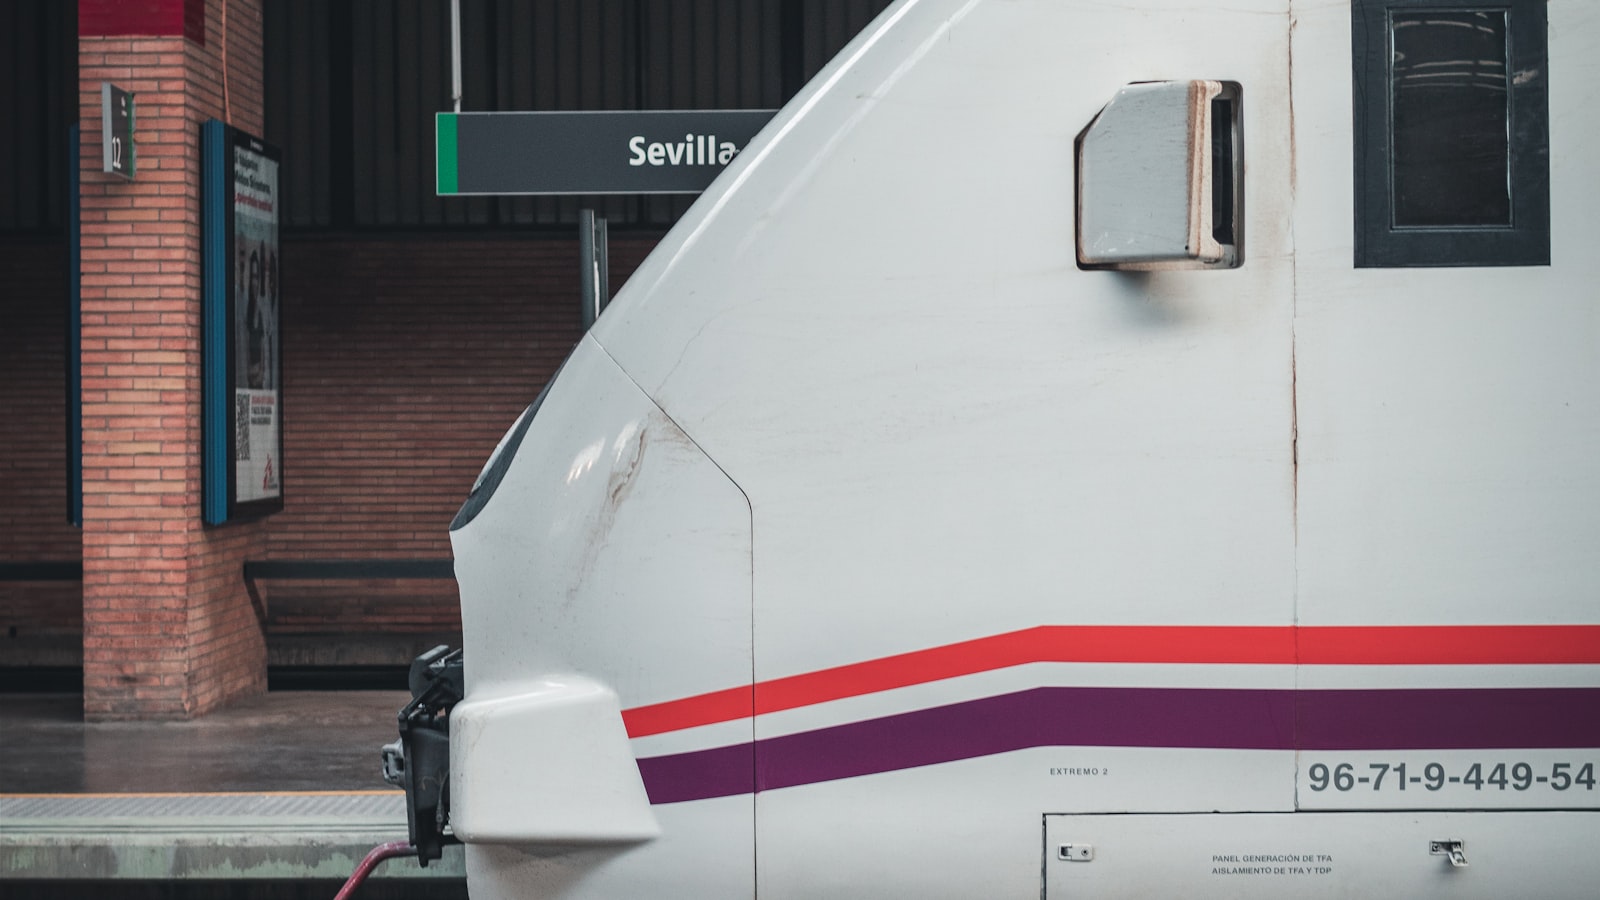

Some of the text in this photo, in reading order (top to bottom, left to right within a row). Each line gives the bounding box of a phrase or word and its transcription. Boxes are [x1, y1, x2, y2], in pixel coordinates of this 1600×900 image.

[112, 136, 121, 169] 12
[628, 133, 737, 166] Sevilla
[1050, 767, 1108, 776] EXTREMO 2
[1308, 762, 1597, 791] 96-71-9-449-54
[1212, 853, 1333, 863] PANEL GENERACIÓN DE TFA
[1212, 867, 1332, 875] AISLAMIENTO DE TFA Y TDP
